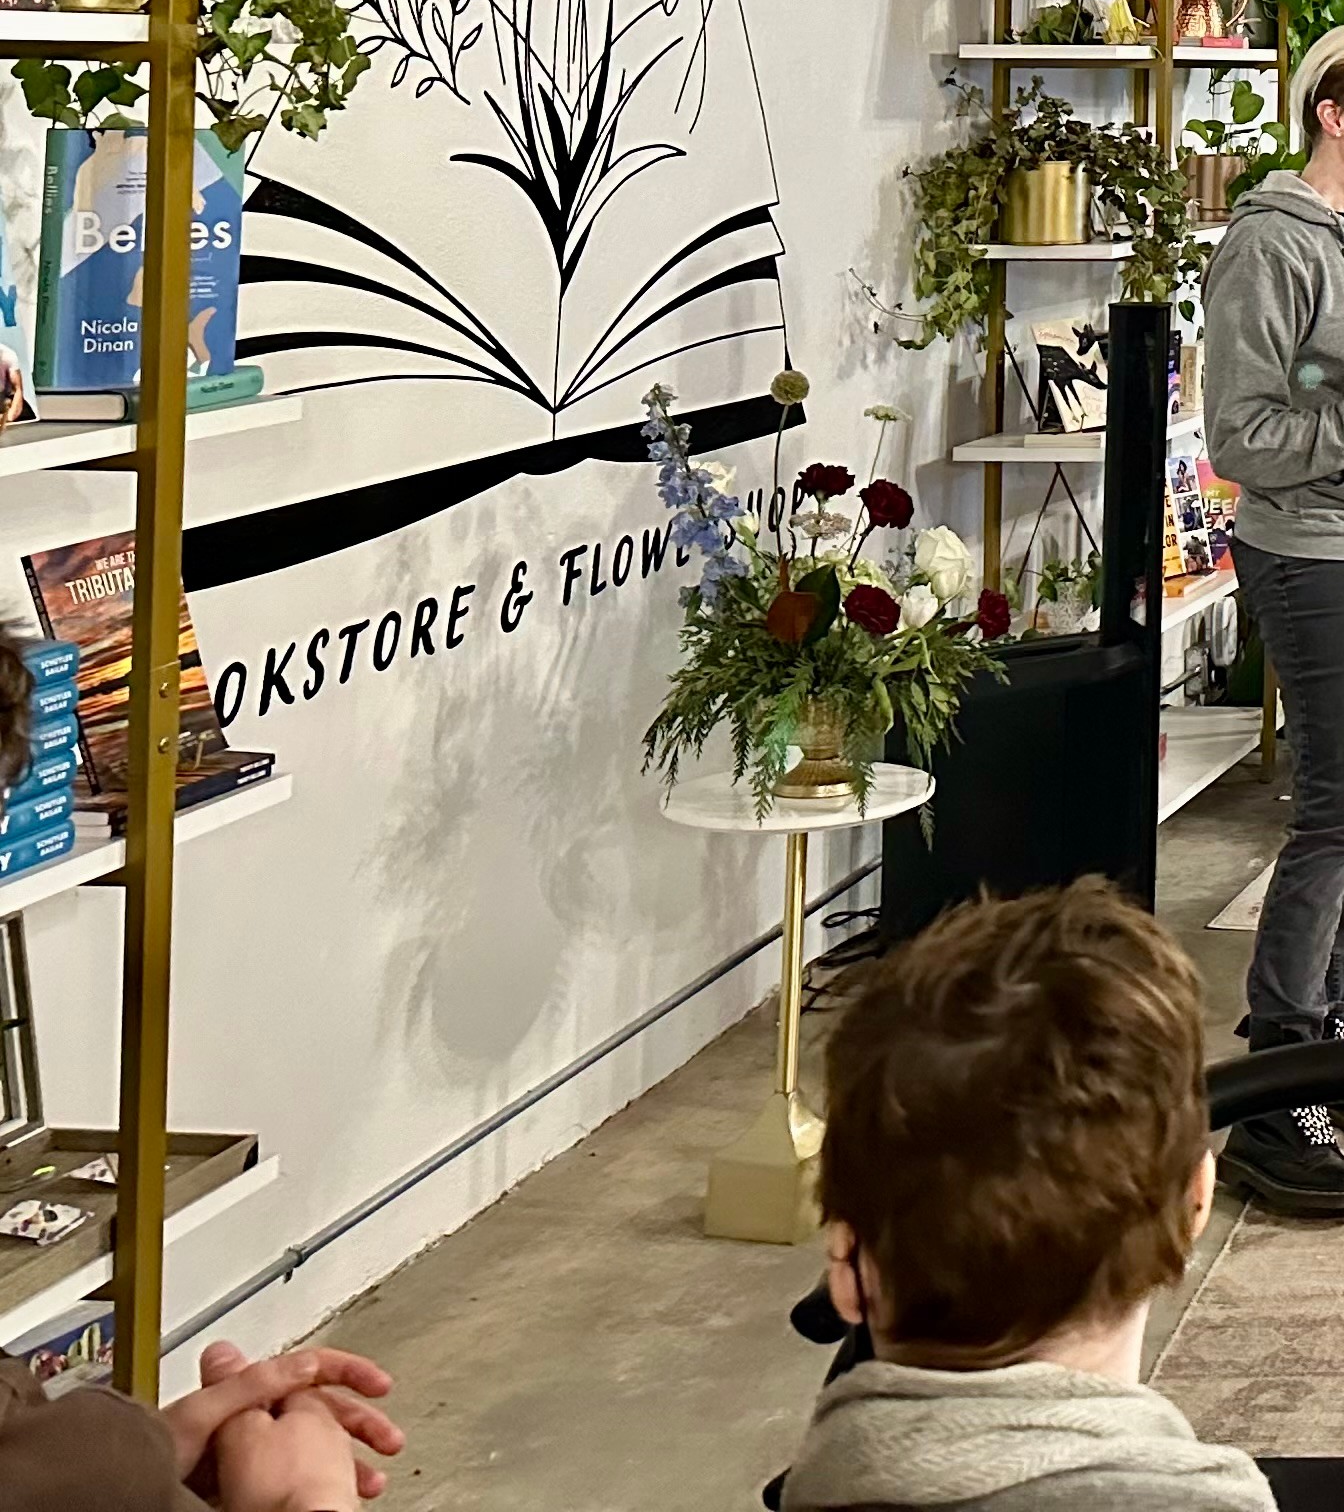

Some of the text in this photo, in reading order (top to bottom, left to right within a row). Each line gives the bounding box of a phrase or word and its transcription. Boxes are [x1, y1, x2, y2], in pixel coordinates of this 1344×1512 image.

[75, 210, 232, 255] Beles
[81, 317, 138, 337] Nicola
[83, 338, 134, 354] Dinan
[95, 557, 109, 571] WE
[110, 554, 126, 567] ARE
[65, 567, 135, 605] TRIBUTA
[214, 583, 476, 729] OKSTORE
[500, 560, 534, 634] &
